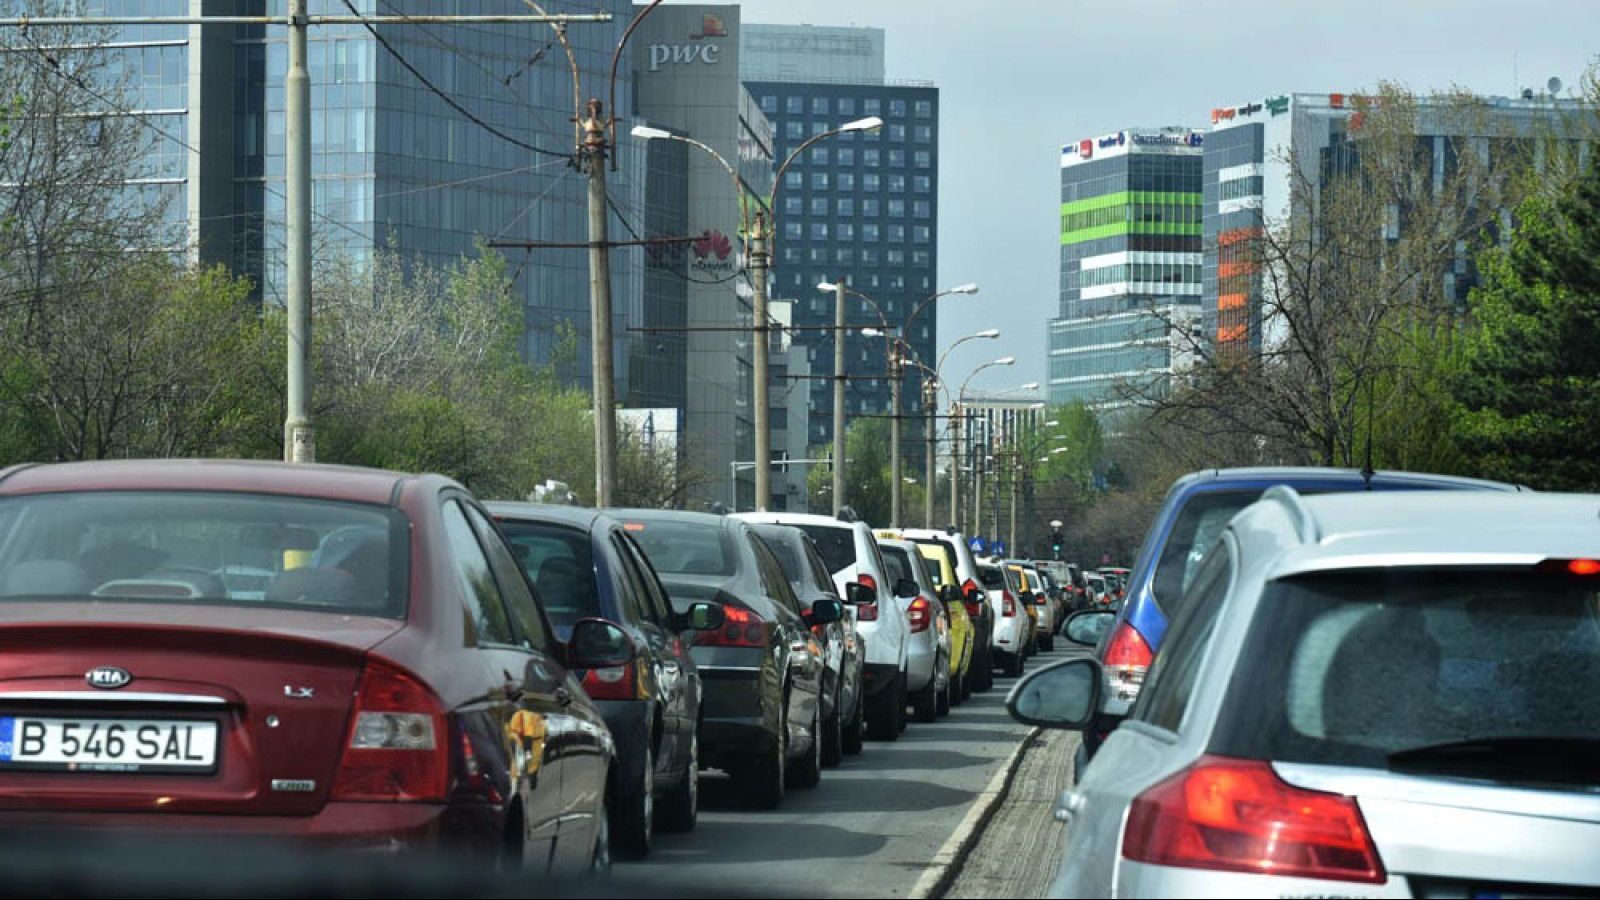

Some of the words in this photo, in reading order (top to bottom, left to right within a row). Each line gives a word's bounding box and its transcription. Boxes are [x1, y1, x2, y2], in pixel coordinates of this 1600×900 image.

[649, 44, 718, 71] pwc
[93, 670, 123, 683] KIA
[284, 685, 313, 697] LX
[19, 720, 47, 756] B
[61, 722, 126, 759] 546
[136, 724, 204, 761] SAL
